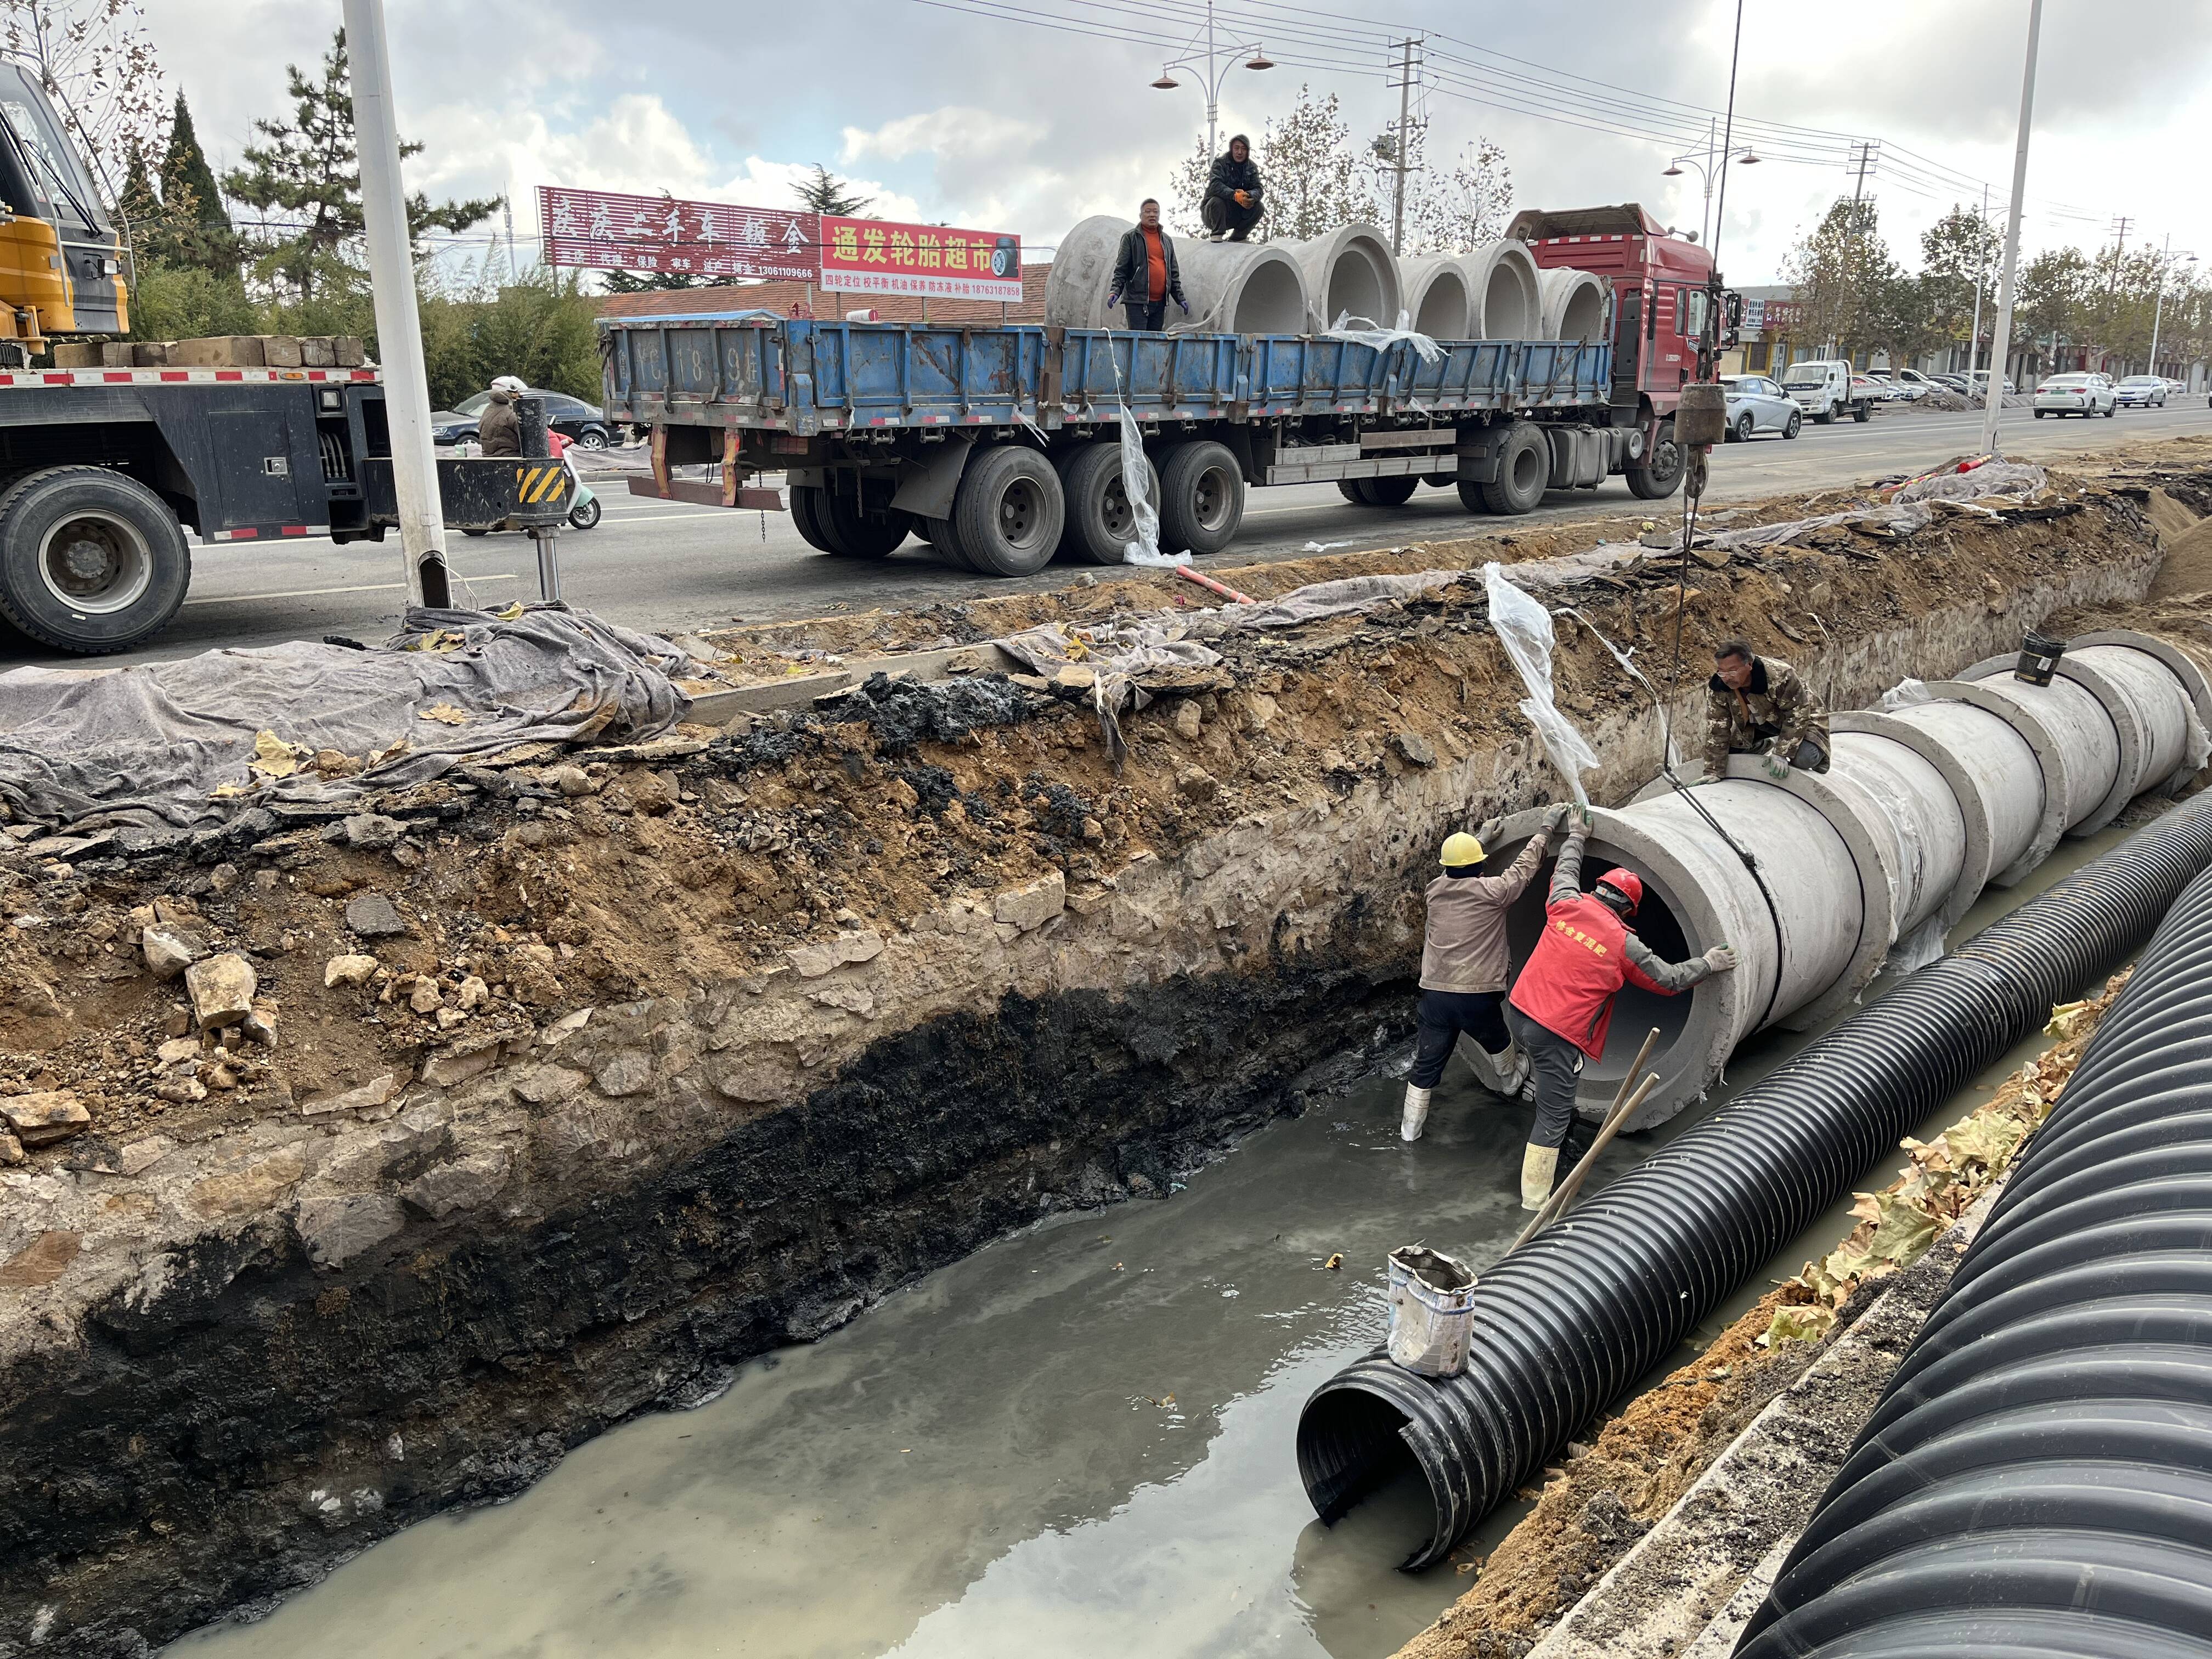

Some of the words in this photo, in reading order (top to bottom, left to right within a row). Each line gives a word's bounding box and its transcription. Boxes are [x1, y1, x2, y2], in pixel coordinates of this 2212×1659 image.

[832, 226, 992, 272] 通发轮胎超市
[637, 256, 657, 267] 保险
[703, 260, 722, 272] 过户
[759, 266, 812, 278] 13061109666
[826, 275, 861, 287] 四轮定位
[864, 277, 888, 289] 校平衡
[891, 279, 907, 290] 机油
[910, 280, 926, 291] 保养
[929, 281, 952, 293] 防冻液
[955, 283, 969, 294] 补胎
[972, 285, 1020, 296] 18763187858
